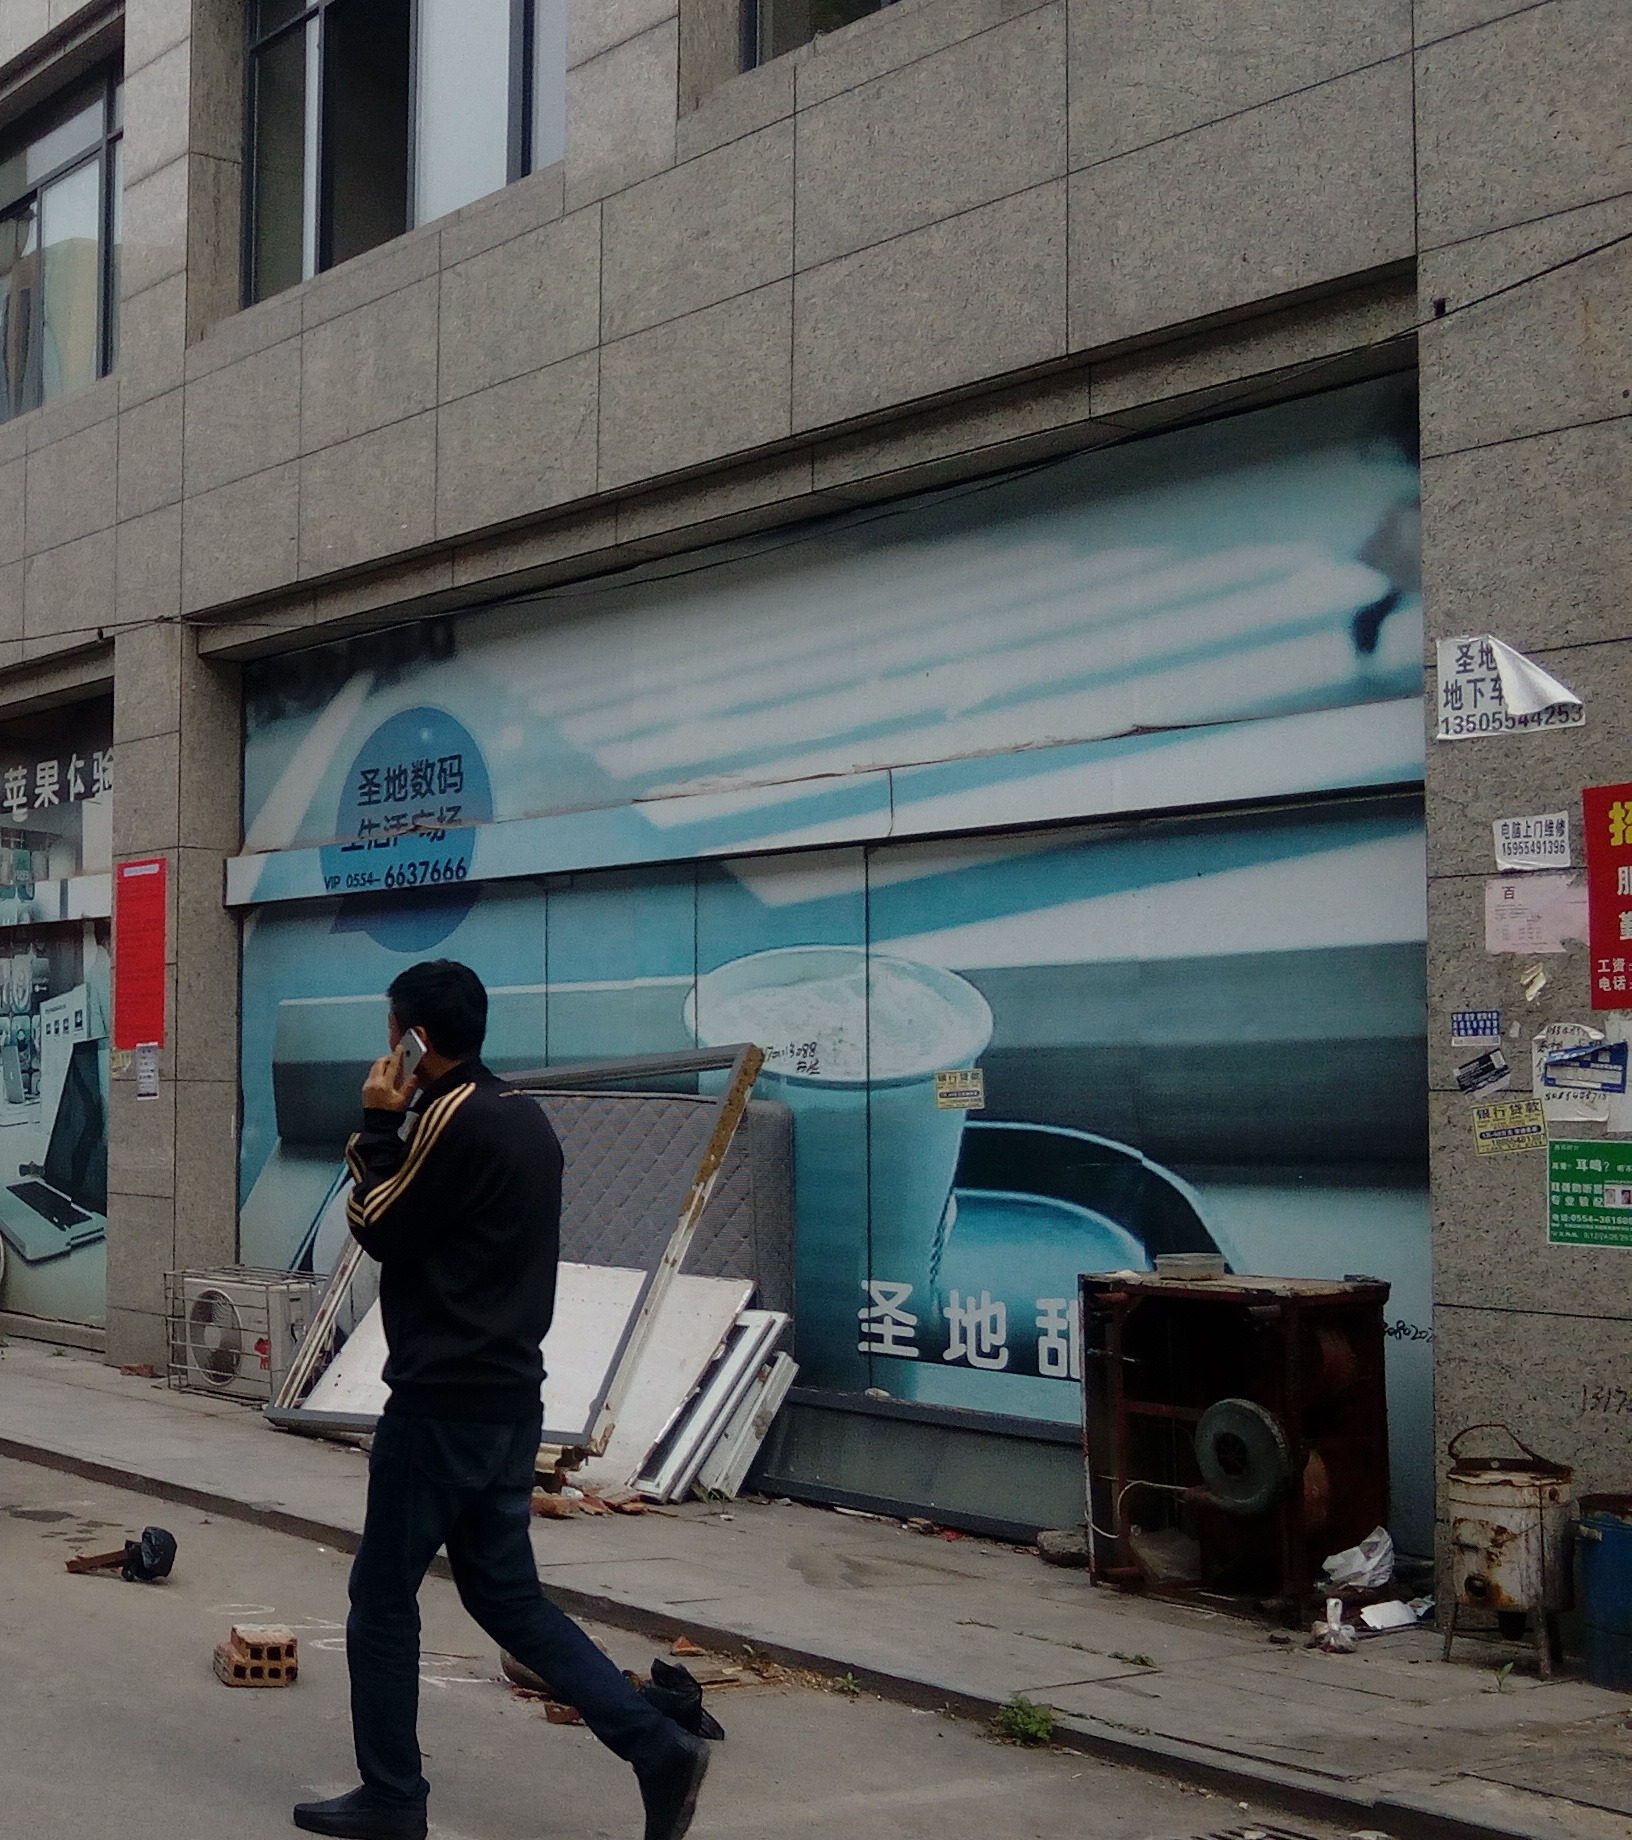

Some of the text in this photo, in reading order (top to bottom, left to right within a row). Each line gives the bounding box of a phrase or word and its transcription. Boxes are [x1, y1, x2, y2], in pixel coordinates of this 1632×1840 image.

[357, 754, 464, 807] 圣地数码
[1501, 817, 1566, 840] 电脑上门维修
[1502, 840, 1566, 856] 15955491396
[324, 876, 341, 890] VIP
